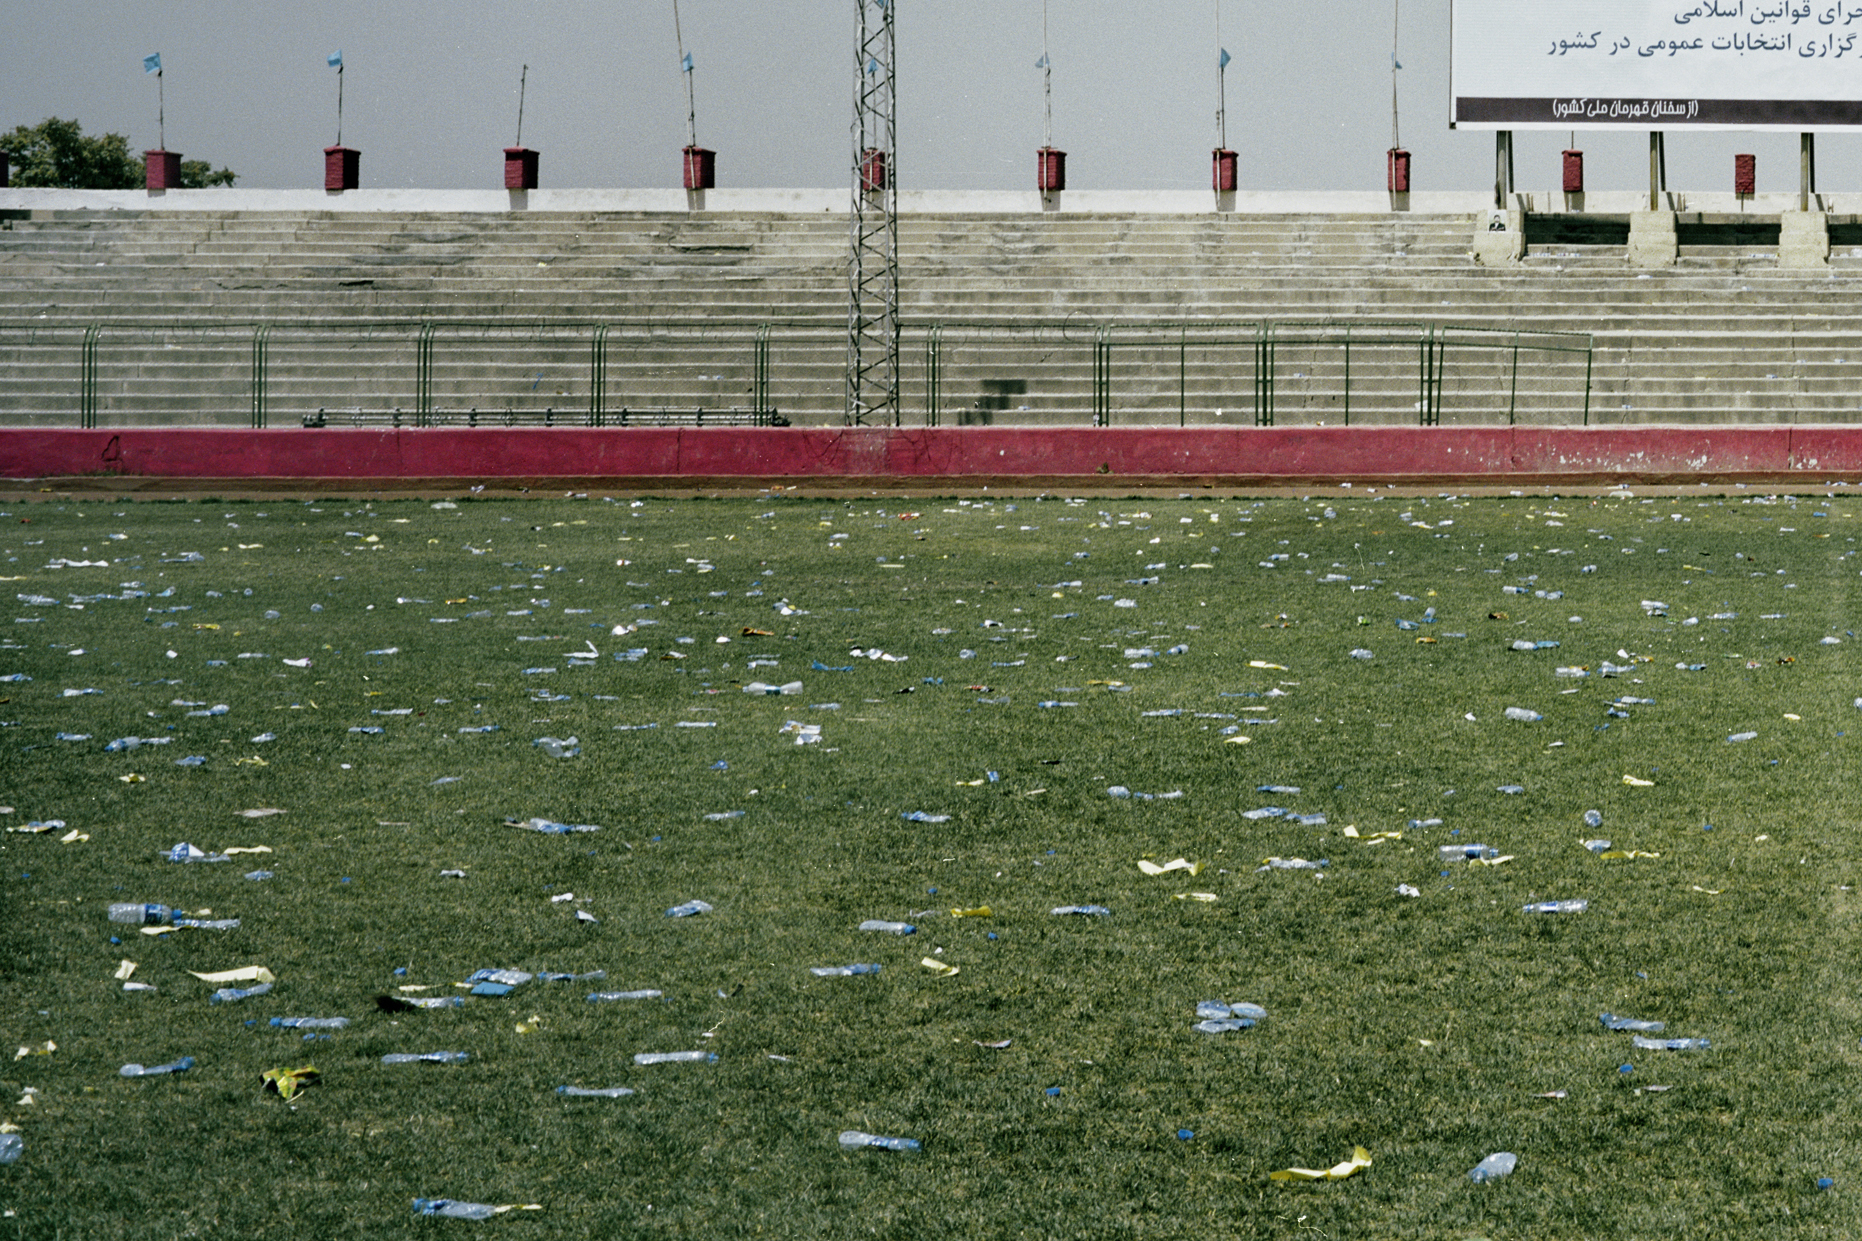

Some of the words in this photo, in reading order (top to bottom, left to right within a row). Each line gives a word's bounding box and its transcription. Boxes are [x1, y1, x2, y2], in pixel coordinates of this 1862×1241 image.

[1674, 0, 1744, 25] اسلامی
[1750, 0, 1811, 25] قوانین
[1547, 31, 1602, 56] کشور
[1609, 36, 1631, 56] در
[1637, 37, 1704, 58] عمومی
[1711, 32, 1792, 56] انتخابات
[1587, 99, 1608, 117] ملی
[1610, 100, 1649, 118] قهرمان
[1651, 100, 1685, 117] سخنان
